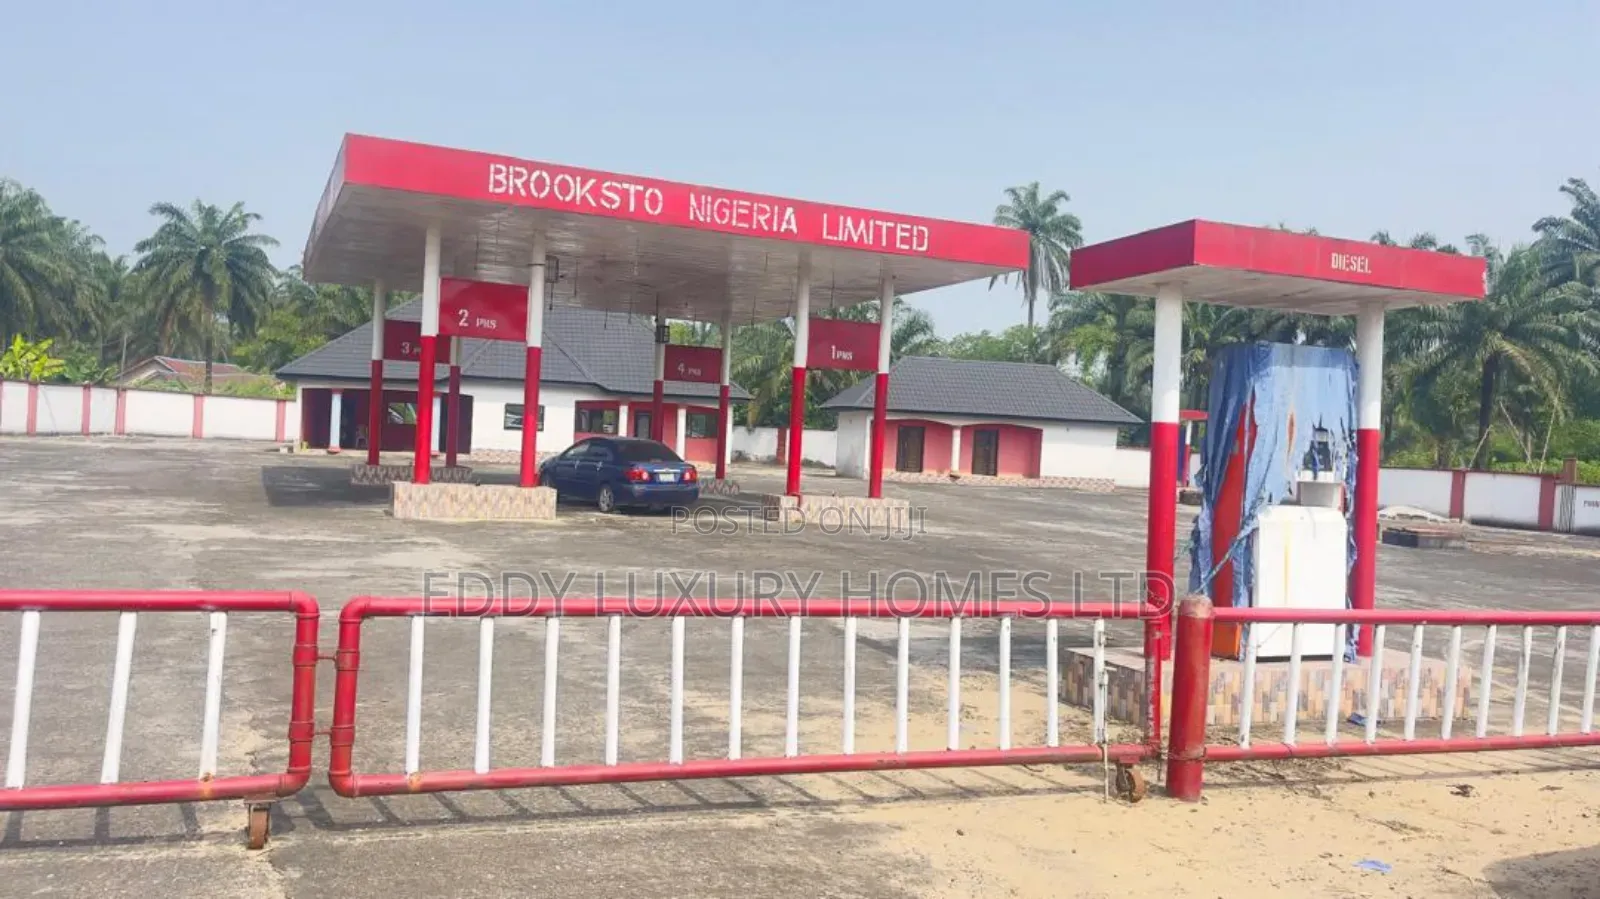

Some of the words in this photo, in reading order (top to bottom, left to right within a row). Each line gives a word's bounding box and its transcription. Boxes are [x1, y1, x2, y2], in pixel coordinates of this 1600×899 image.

[488, 163, 664, 216] BROOKSTO
[689, 192, 798, 236] NIGERIA
[822, 213, 929, 252] LIMITED
[1331, 252, 1372, 274] DIESEL
[458, 309, 469, 327] 2
[401, 342, 410, 354] 3
[831, 345, 837, 360] 1
[678, 362, 685, 375] 4
